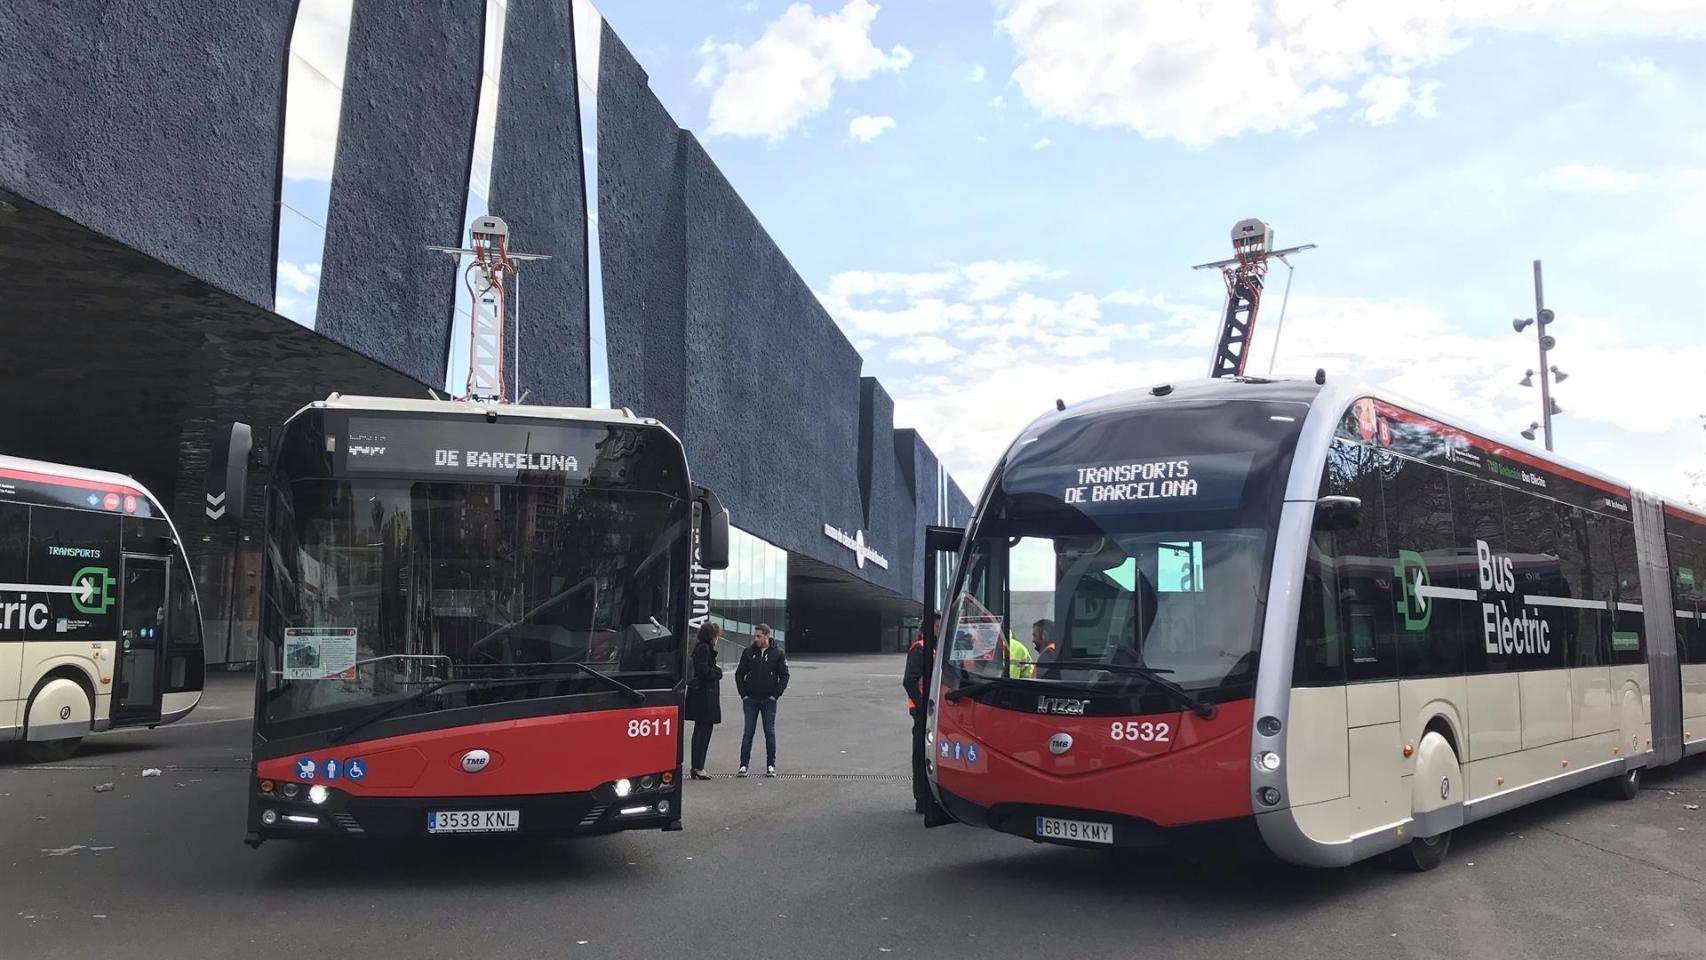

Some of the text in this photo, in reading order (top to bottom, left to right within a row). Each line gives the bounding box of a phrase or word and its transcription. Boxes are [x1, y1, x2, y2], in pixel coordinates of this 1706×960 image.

[435, 449, 578, 472] DE BARCELONA
[1077, 460, 1189, 484] TRANSPORTS
[1065, 479, 1198, 504] DE BARCELONA
[48, 546, 101, 559] TRANSPORTS
[1476, 539, 1516, 595] Bus
[1482, 600, 1551, 655] Elèctric
[627, 718, 671, 738] 8611
[1110, 721, 1170, 742] 8532
[439, 812, 515, 828] 3538 KNL
[1045, 820, 1109, 841] 6819 KMY
